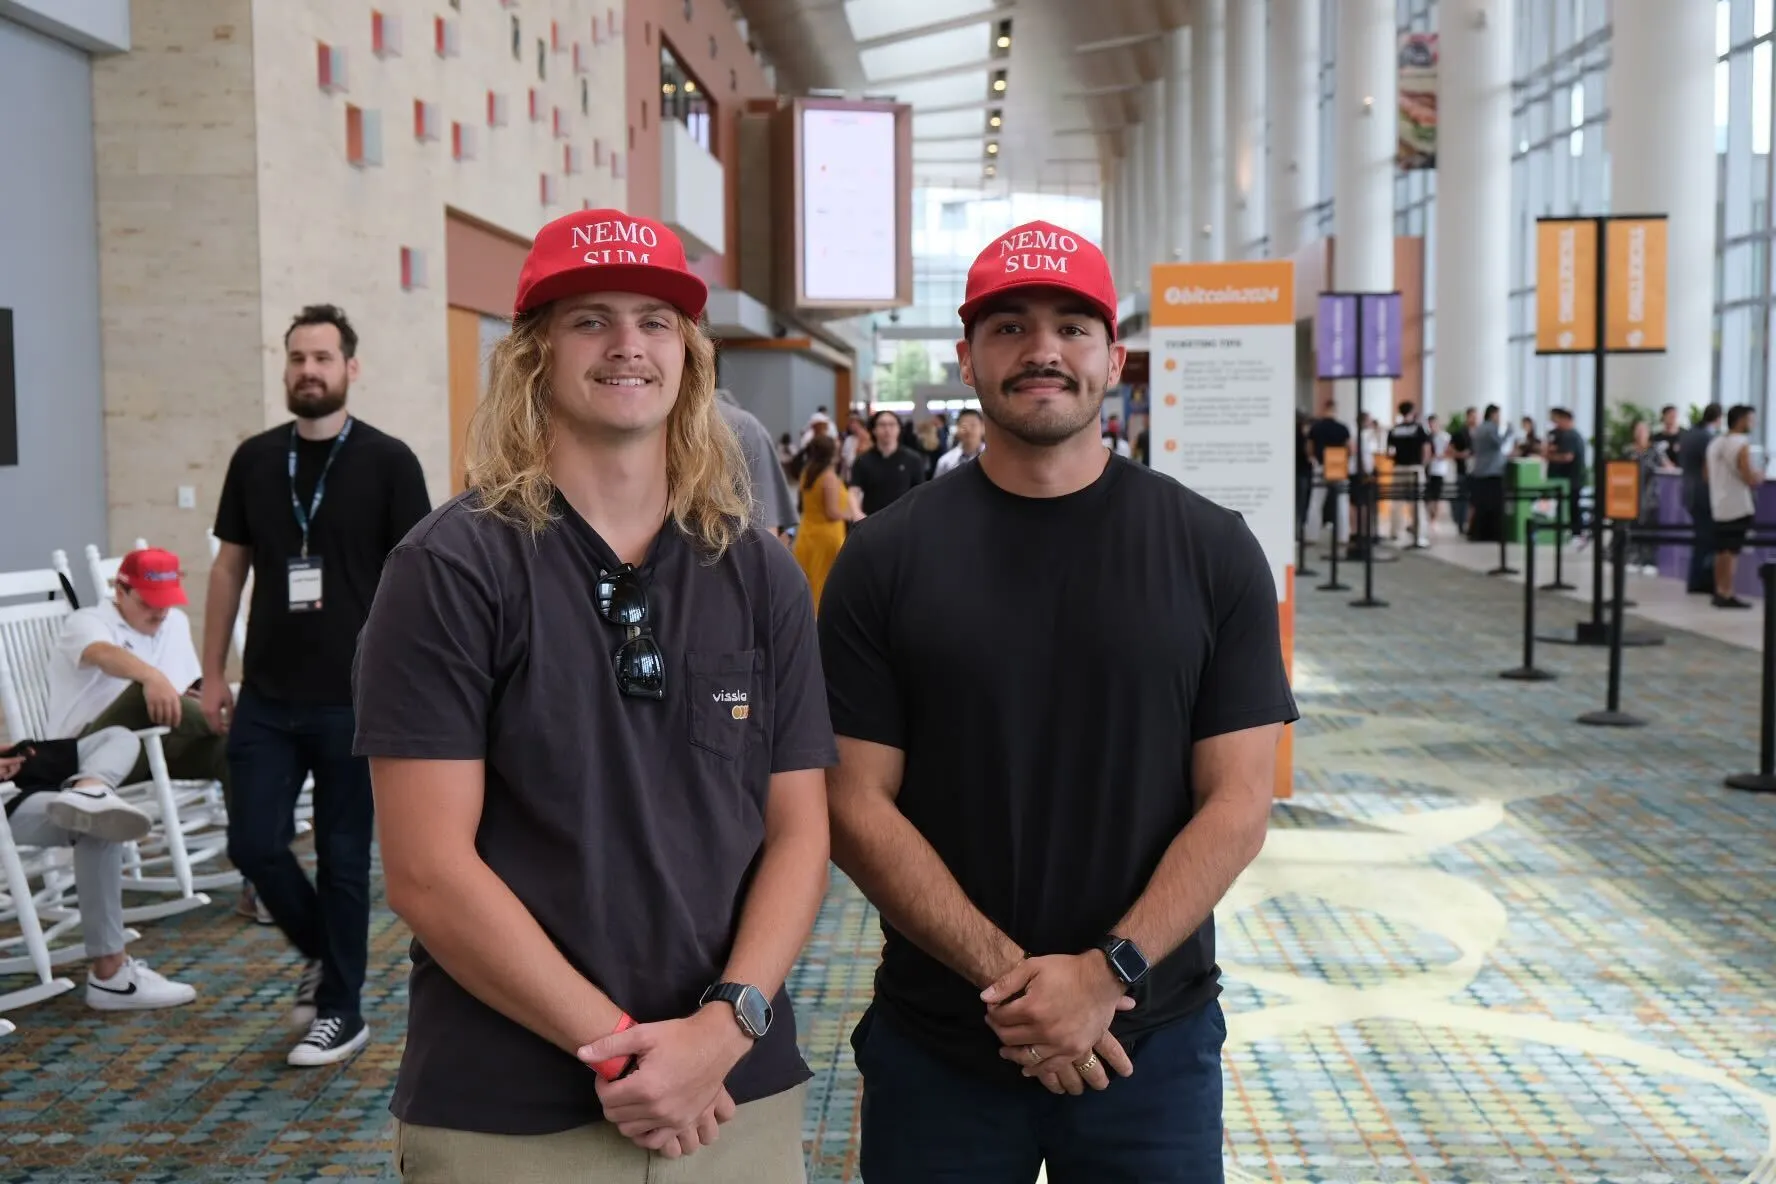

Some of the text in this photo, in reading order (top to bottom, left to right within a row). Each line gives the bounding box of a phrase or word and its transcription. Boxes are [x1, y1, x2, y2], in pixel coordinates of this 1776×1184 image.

[571, 220, 657, 248] NEMO
[1000, 230, 1079, 257] NEMO
[1005, 253, 1068, 274] SUM
[712, 689, 747, 702] vissla
